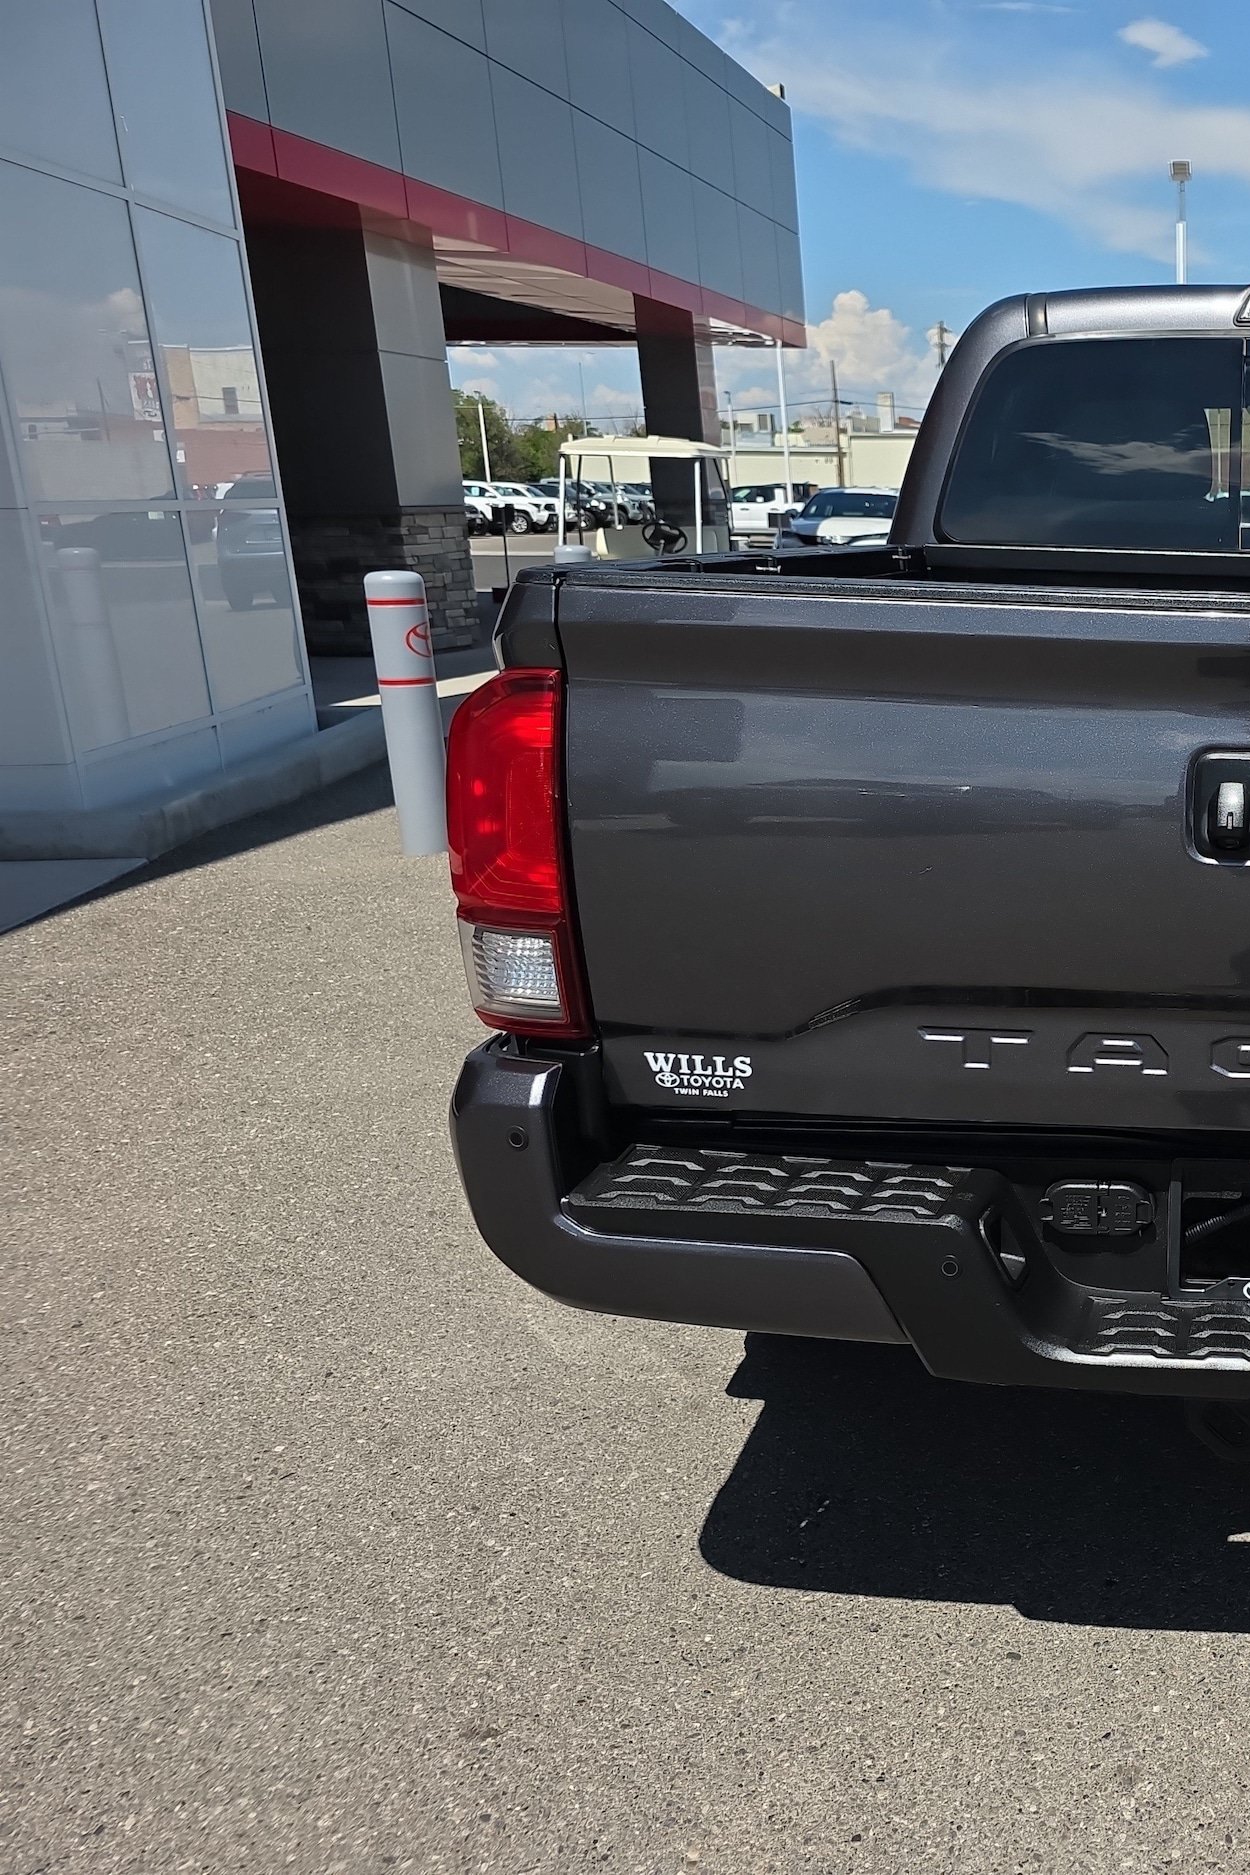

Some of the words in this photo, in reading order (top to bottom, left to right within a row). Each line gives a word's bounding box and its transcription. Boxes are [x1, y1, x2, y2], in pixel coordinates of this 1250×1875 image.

[643, 1051, 753, 1077] WILLS
[680, 1074, 745, 1089] TOYOTA
[673, 1087, 700, 1096] TWIN
[702, 1088, 729, 1097] FALLS
